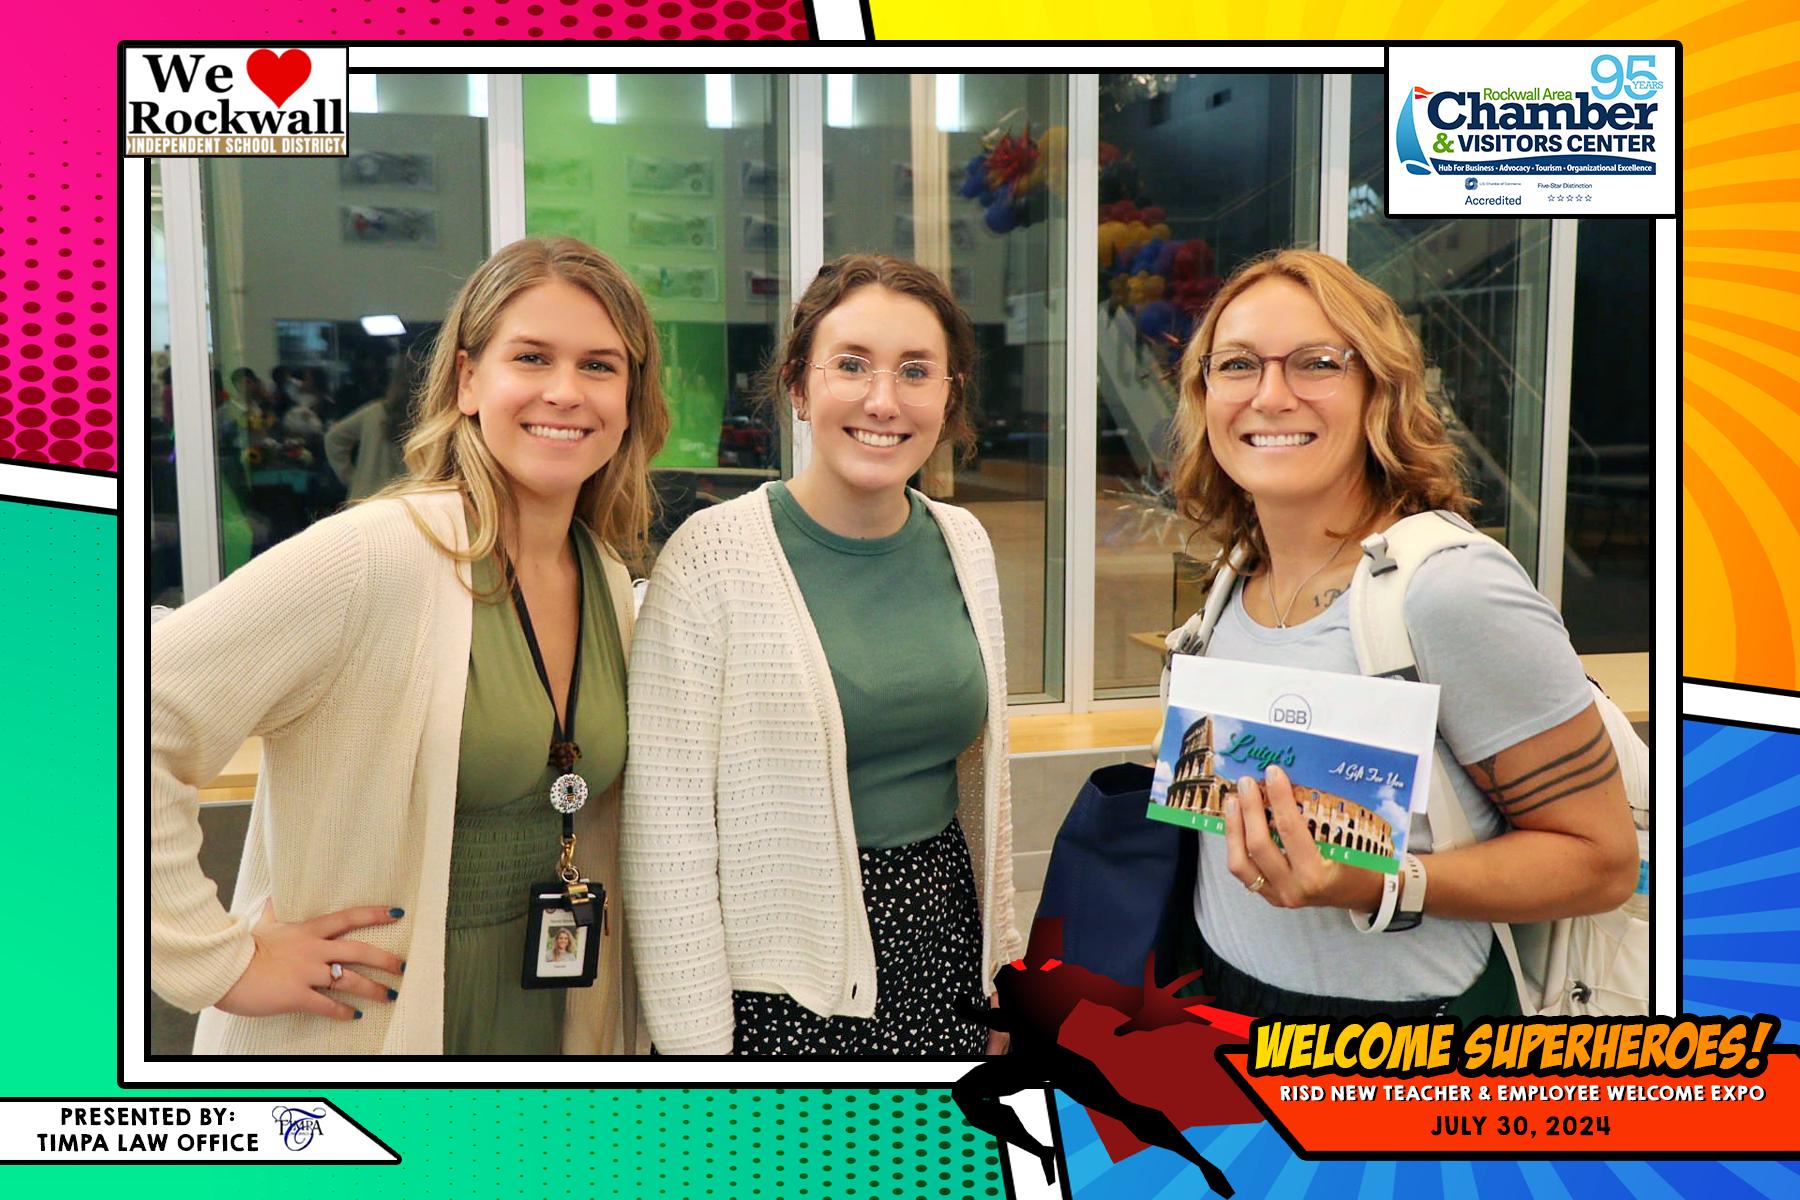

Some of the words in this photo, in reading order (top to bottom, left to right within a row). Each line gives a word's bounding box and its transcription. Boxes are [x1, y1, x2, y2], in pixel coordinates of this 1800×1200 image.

[1273, 708, 1308, 725] DBB
[1220, 733, 1297, 772] Luigi's
[1328, 761, 1346, 775] A
[1345, 764, 1365, 781] Gift
[1366, 767, 1384, 783] For
[1386, 771, 1404, 788] You
